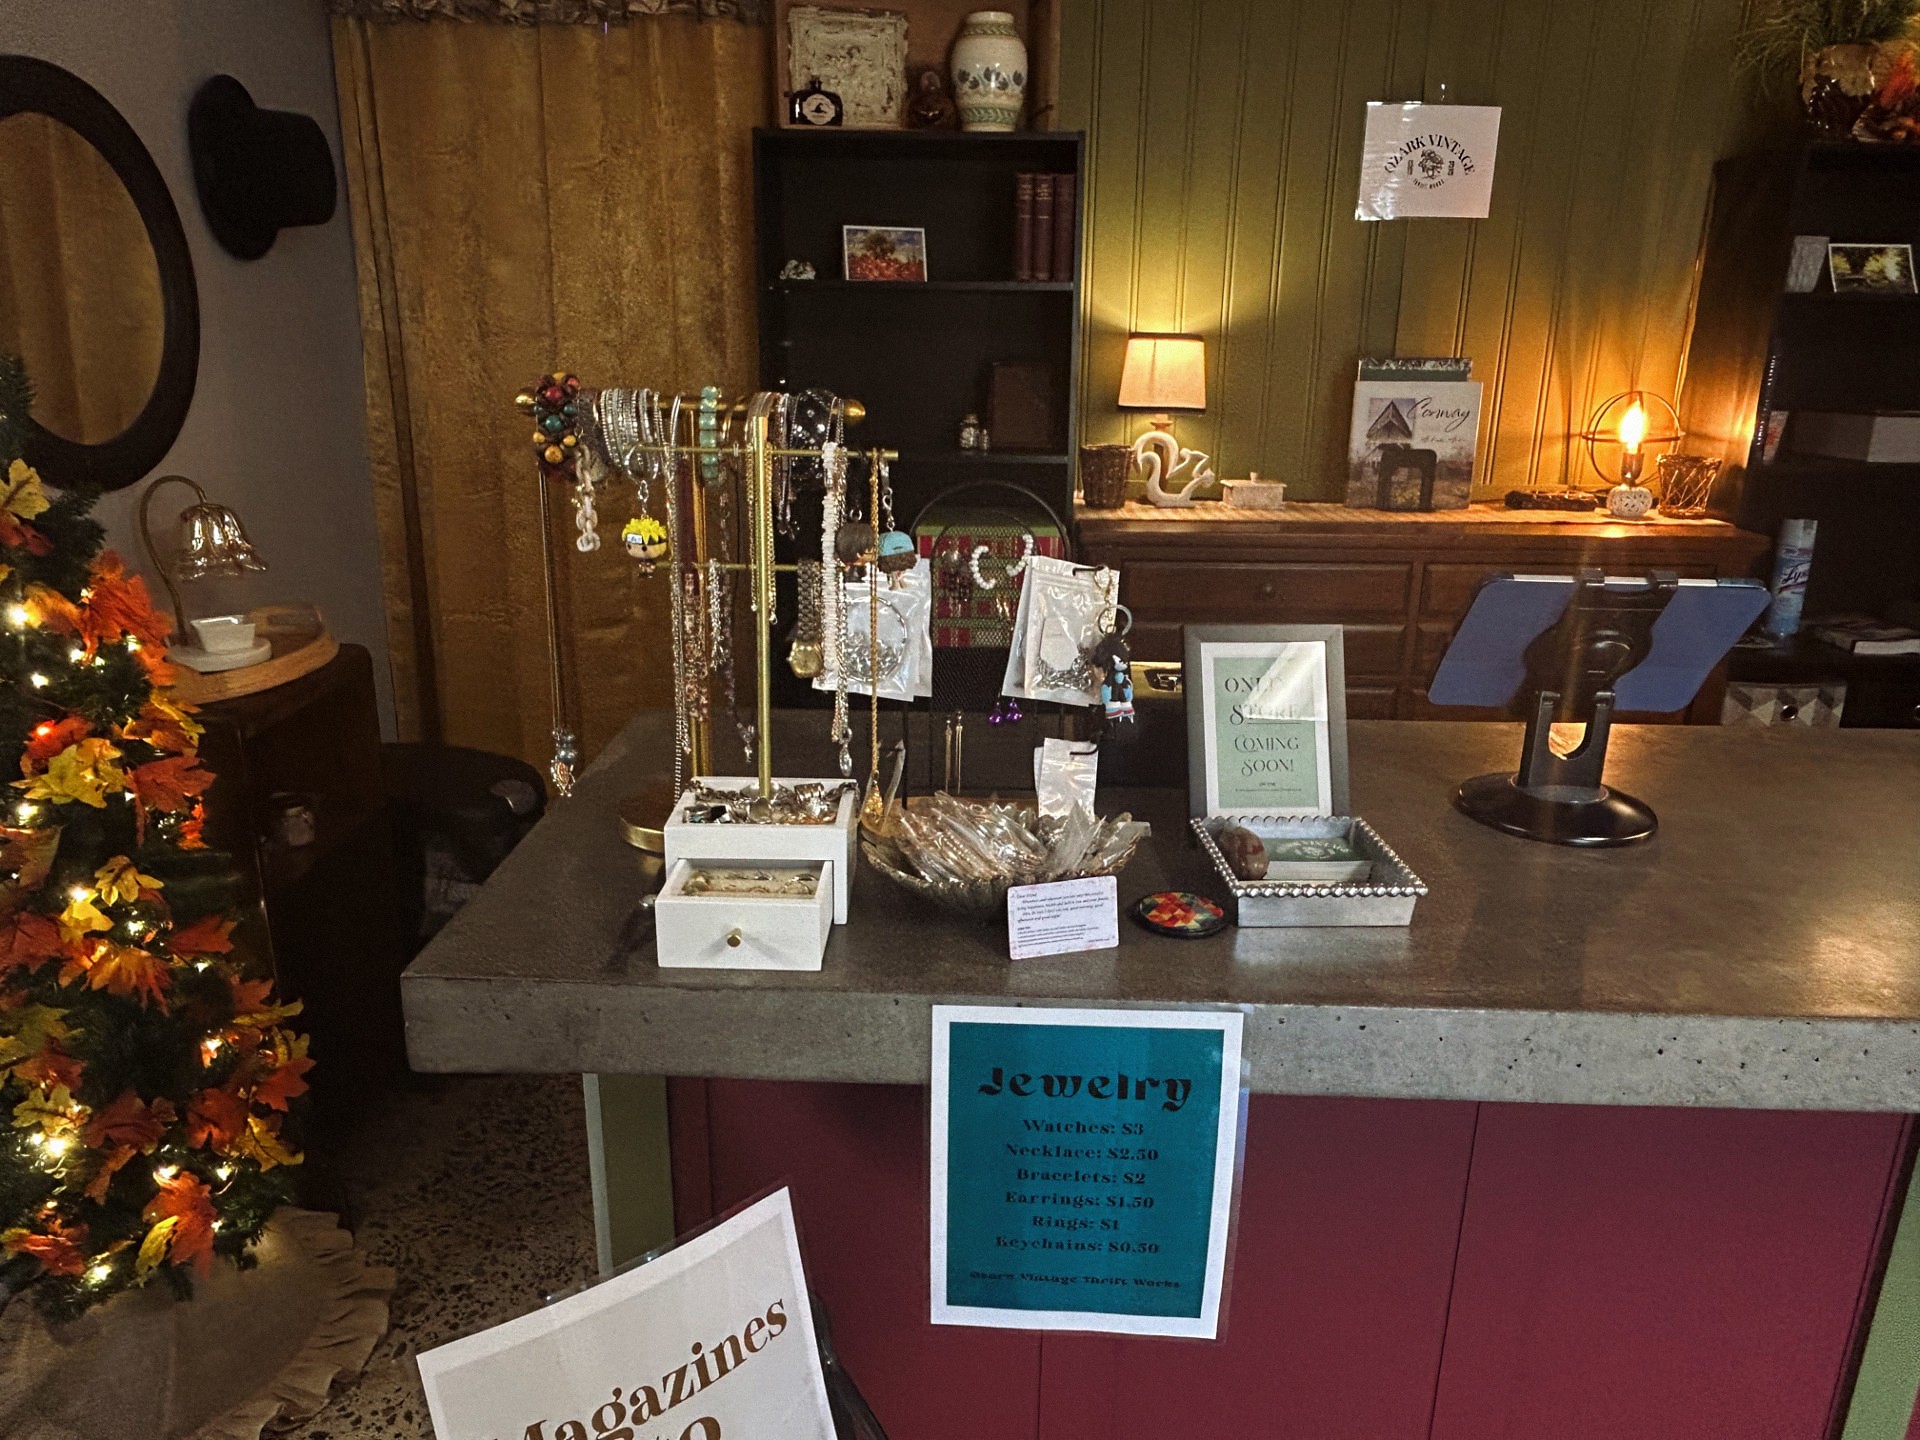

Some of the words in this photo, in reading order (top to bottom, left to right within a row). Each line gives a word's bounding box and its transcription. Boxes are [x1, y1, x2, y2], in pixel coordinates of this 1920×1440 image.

[1384, 135, 1426, 174] OZARK
[1428, 133, 1476, 176] VINTAGE
[1234, 734, 1300, 753] COMING
[1241, 758, 1295, 777] SOON!
[978, 1067, 1192, 1112] Jewelry
[1022, 1118, 1117, 1135] Watches:
[1121, 1122, 1145, 1136] $3
[1006, 1142, 1102, 1160] Necklace:
[1106, 1147, 1160, 1161] $2.50
[1016, 1167, 1118, 1184] Bracelets:
[1122, 1172, 1147, 1185] $2
[1005, 1191, 1101, 1209] Earrings:
[1105, 1196, 1155, 1209] $1.50
[1031, 1215, 1096, 1231] Rings:
[1099, 1218, 1120, 1231] $1
[995, 1235, 1103, 1252] Keychains:
[1107, 1241, 1161, 1255] $0.50
